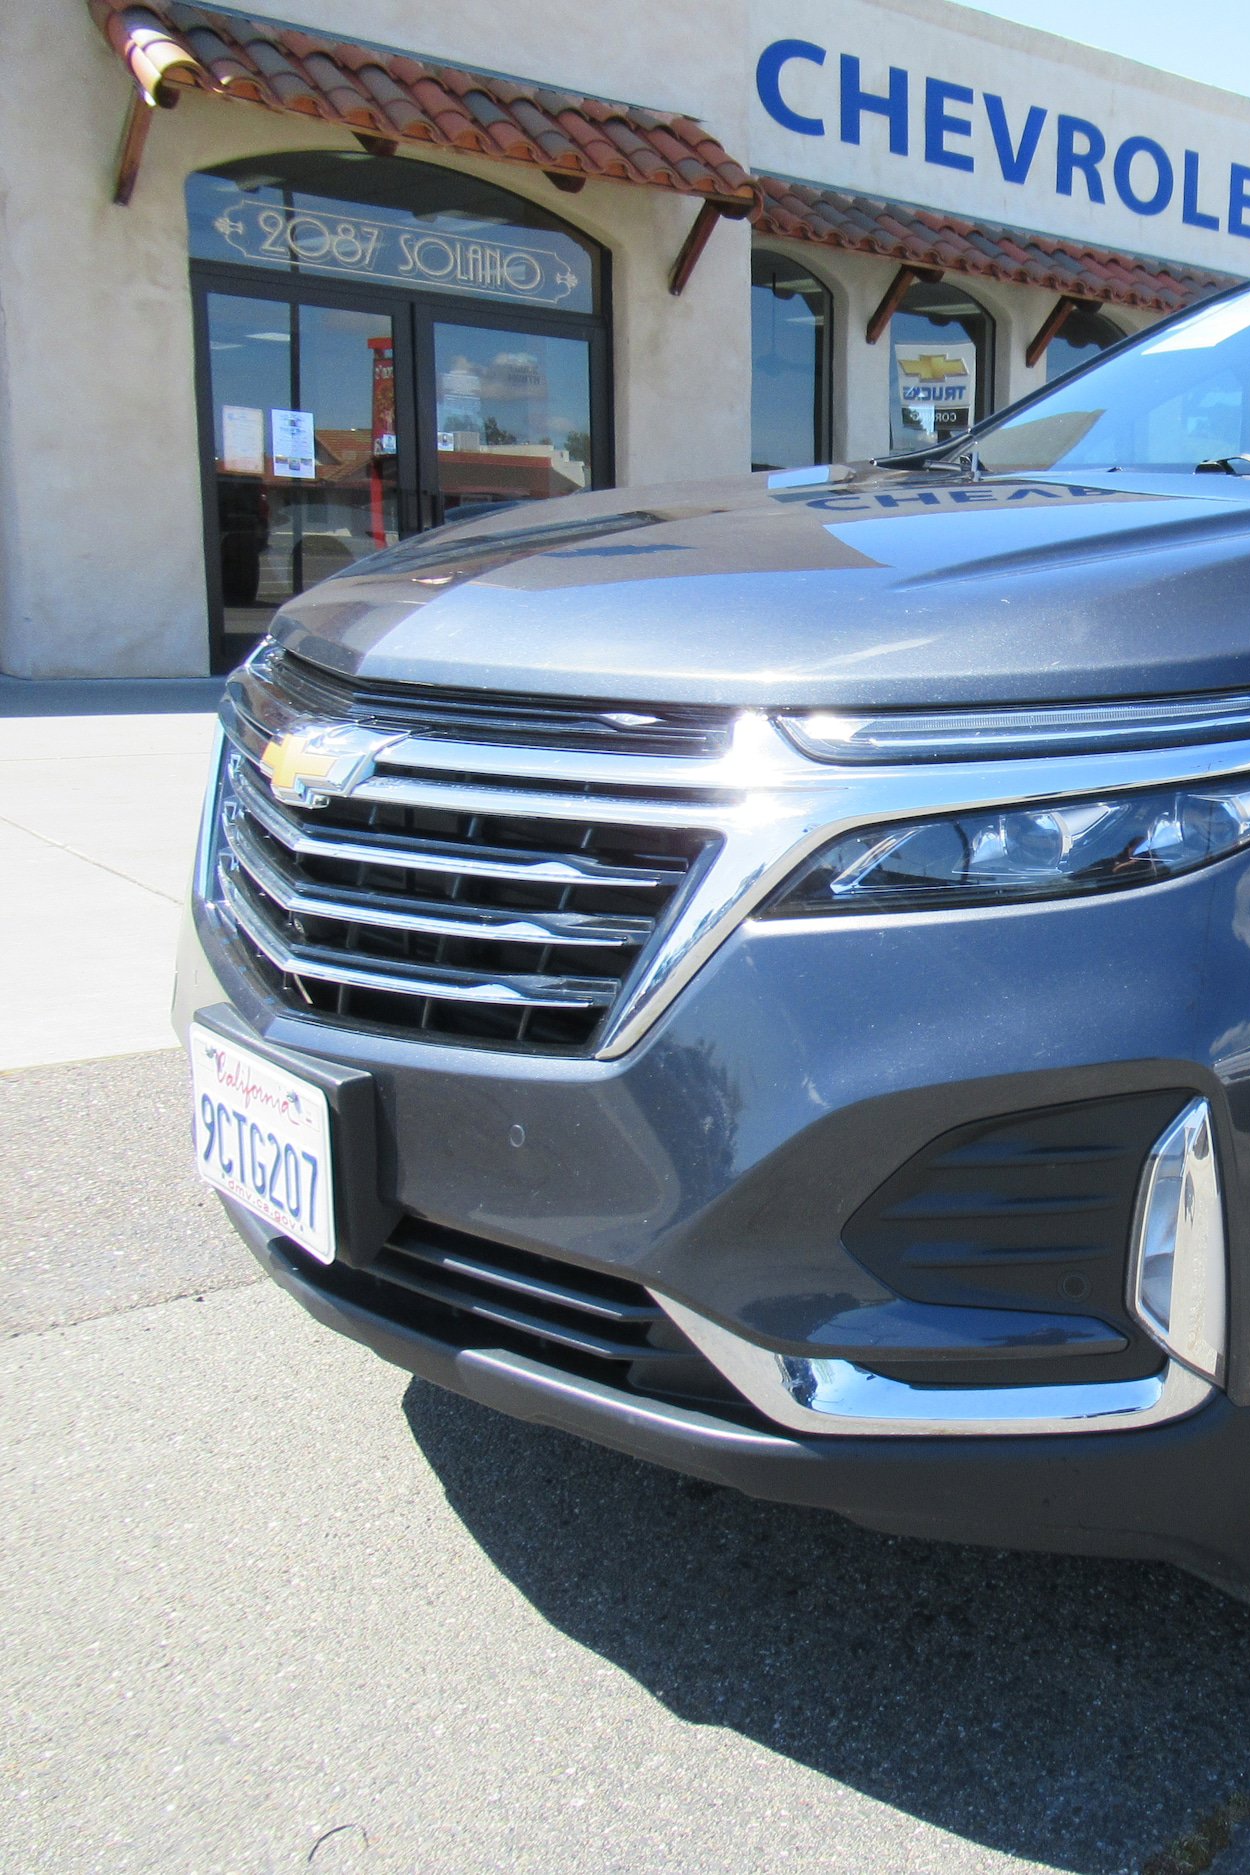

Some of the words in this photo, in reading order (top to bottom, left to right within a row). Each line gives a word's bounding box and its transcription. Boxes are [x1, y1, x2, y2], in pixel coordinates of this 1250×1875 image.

[257, 211, 387, 269] 2087
[400, 234, 545, 292] SOLANO
[214, 1050, 300, 1126] California
[201, 1093, 318, 1232] 9CTG207
[227, 1180, 296, 1230] dmv.ca.gov
